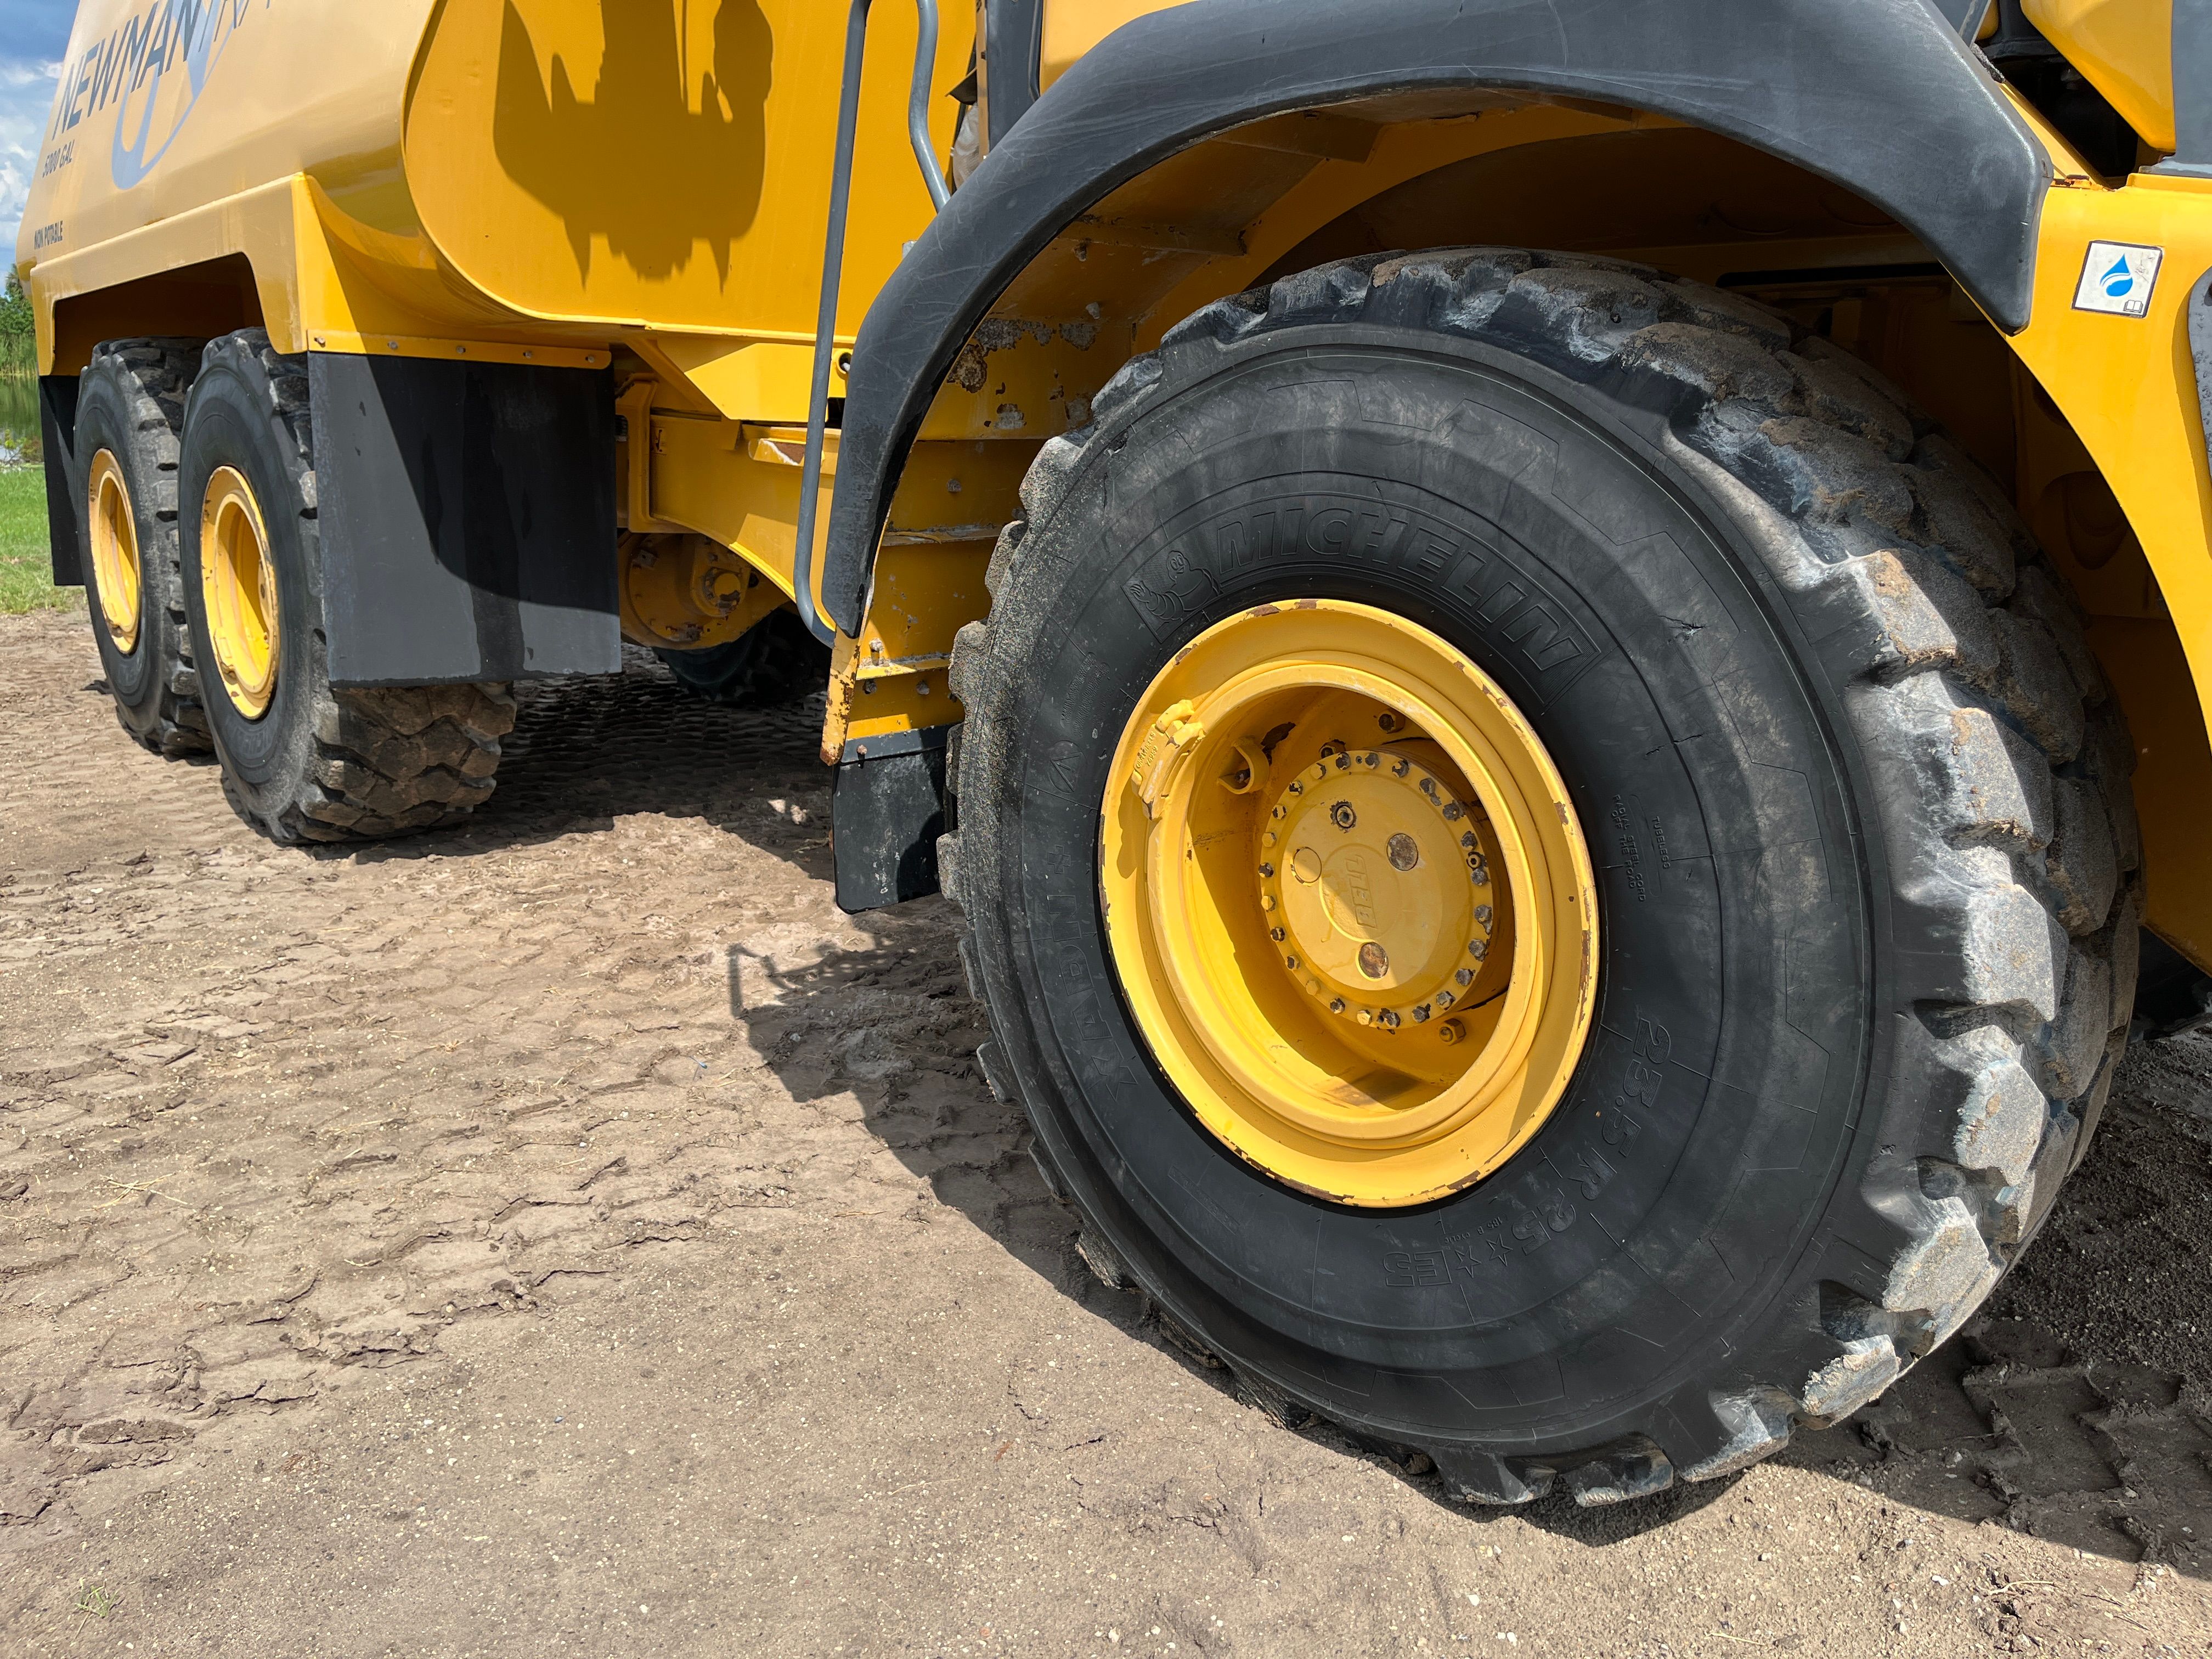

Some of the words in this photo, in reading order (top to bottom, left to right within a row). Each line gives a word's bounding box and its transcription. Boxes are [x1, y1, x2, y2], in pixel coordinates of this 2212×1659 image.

[52, 0, 201, 140] NEWMAN
[59, 139, 75, 168] GAL
[35, 228, 44, 250] NON
[44, 220, 63, 246] POTABLE
[1217, 506, 1583, 672] MICHELIN
[1611, 810, 1622, 830] OFF
[1618, 834, 1630, 855] THE
[1624, 860, 1637, 888] ROAD
[1612, 794, 1630, 830] RADIAL
[1626, 835, 1640, 868] STEEL
[1635, 872, 1646, 901] CORD
[1652, 816, 1671, 870] TUBELESS
[1601, 1018, 1671, 1158] 23.5
